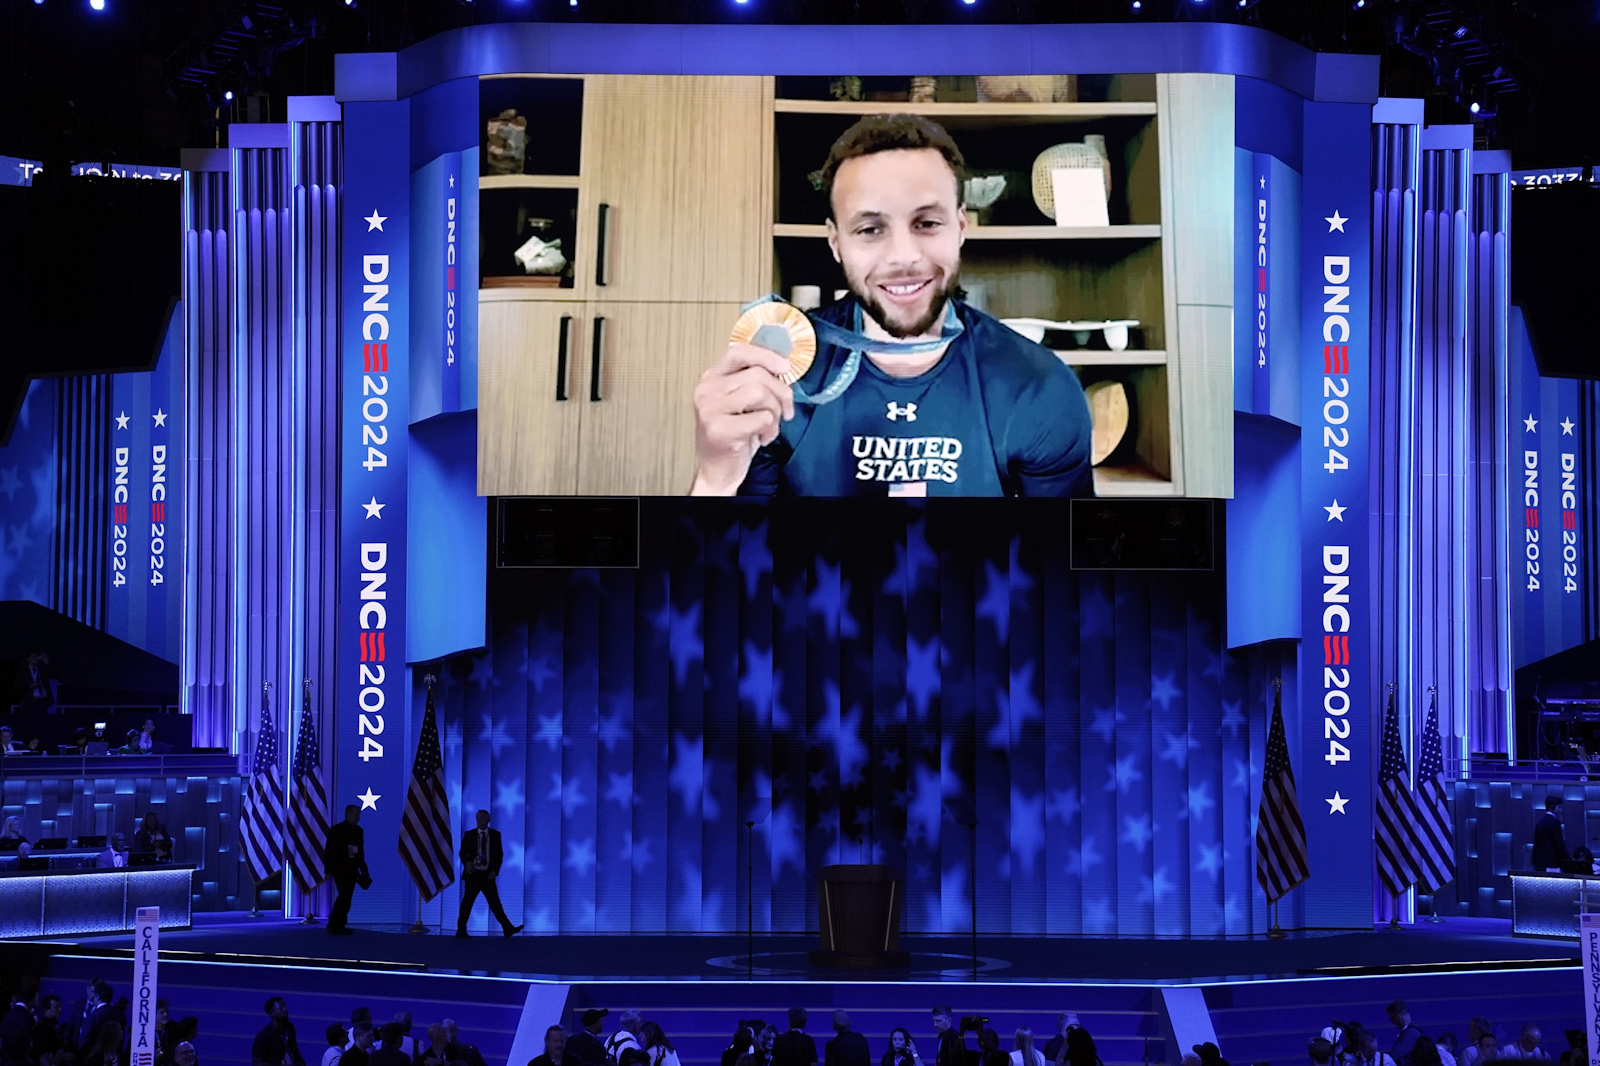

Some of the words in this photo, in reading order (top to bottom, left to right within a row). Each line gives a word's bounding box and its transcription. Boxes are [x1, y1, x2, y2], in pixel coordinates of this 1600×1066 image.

[852, 436, 962, 459] UNITED
[856, 458, 958, 482] STATES
[137, 926, 152, 1048] CALIFORNIA
